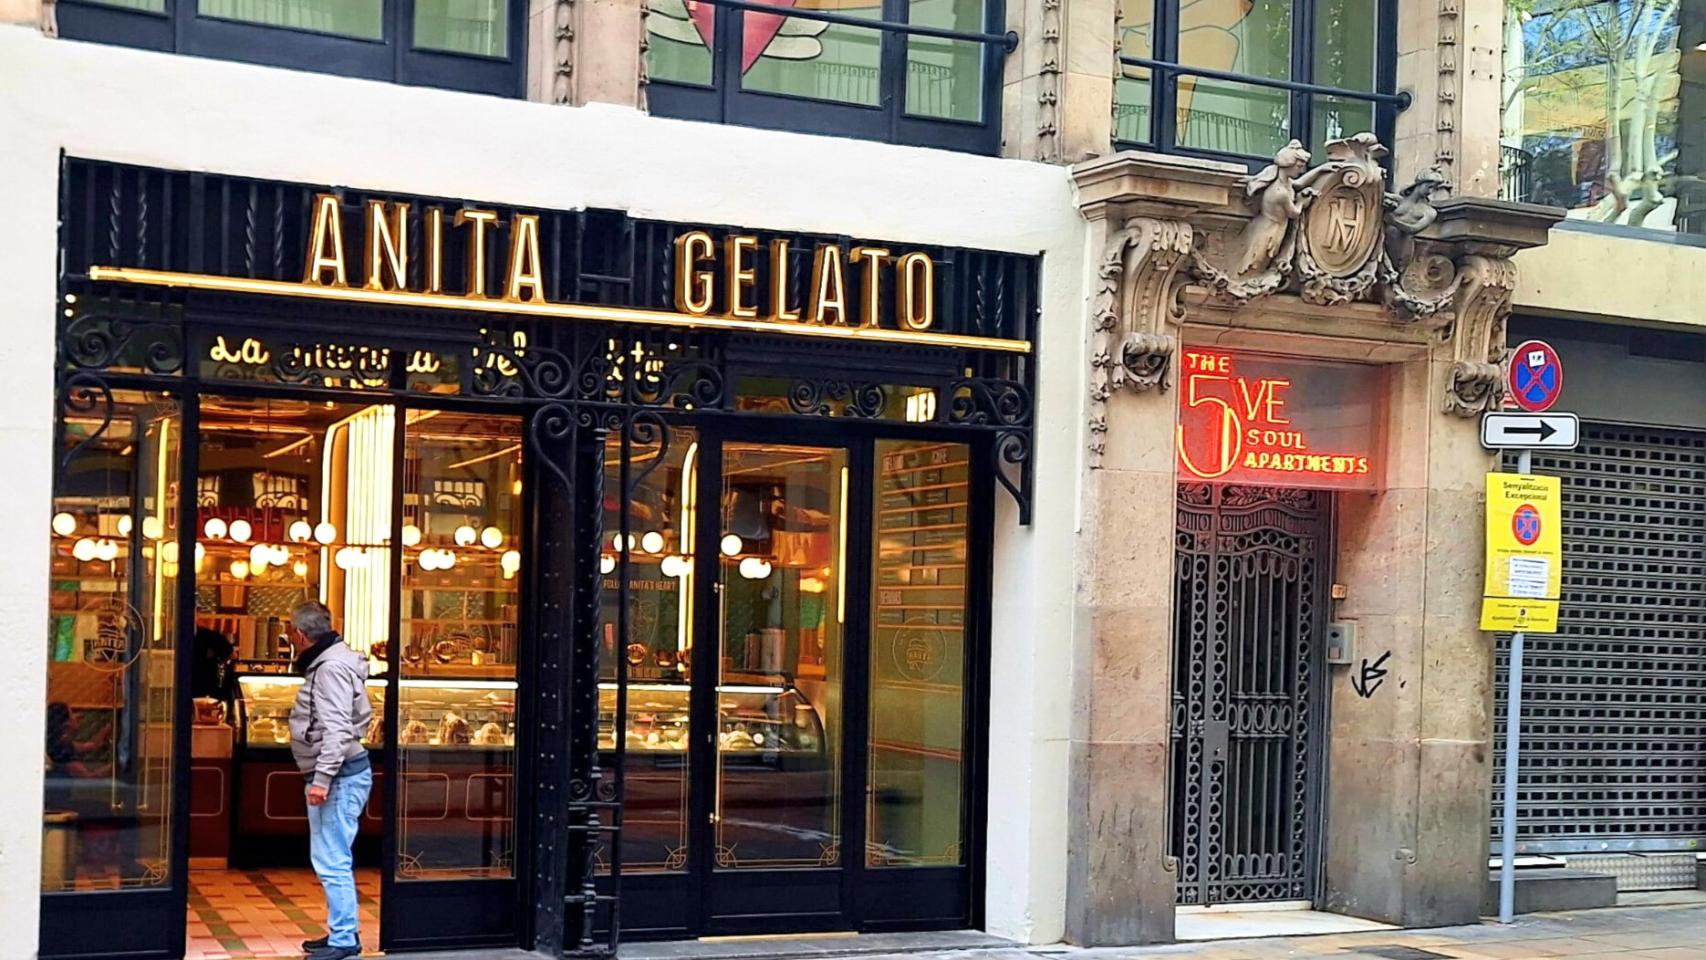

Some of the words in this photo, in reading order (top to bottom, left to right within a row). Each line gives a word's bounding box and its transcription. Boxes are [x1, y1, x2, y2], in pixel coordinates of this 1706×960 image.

[305, 194, 544, 302] ANITA
[674, 232, 934, 331] GELATO
[209, 336, 270, 364] La
[1186, 352, 1231, 373] THE
[1246, 429, 1307, 449] SOUL
[1243, 452, 1369, 474] APARTMENTS
